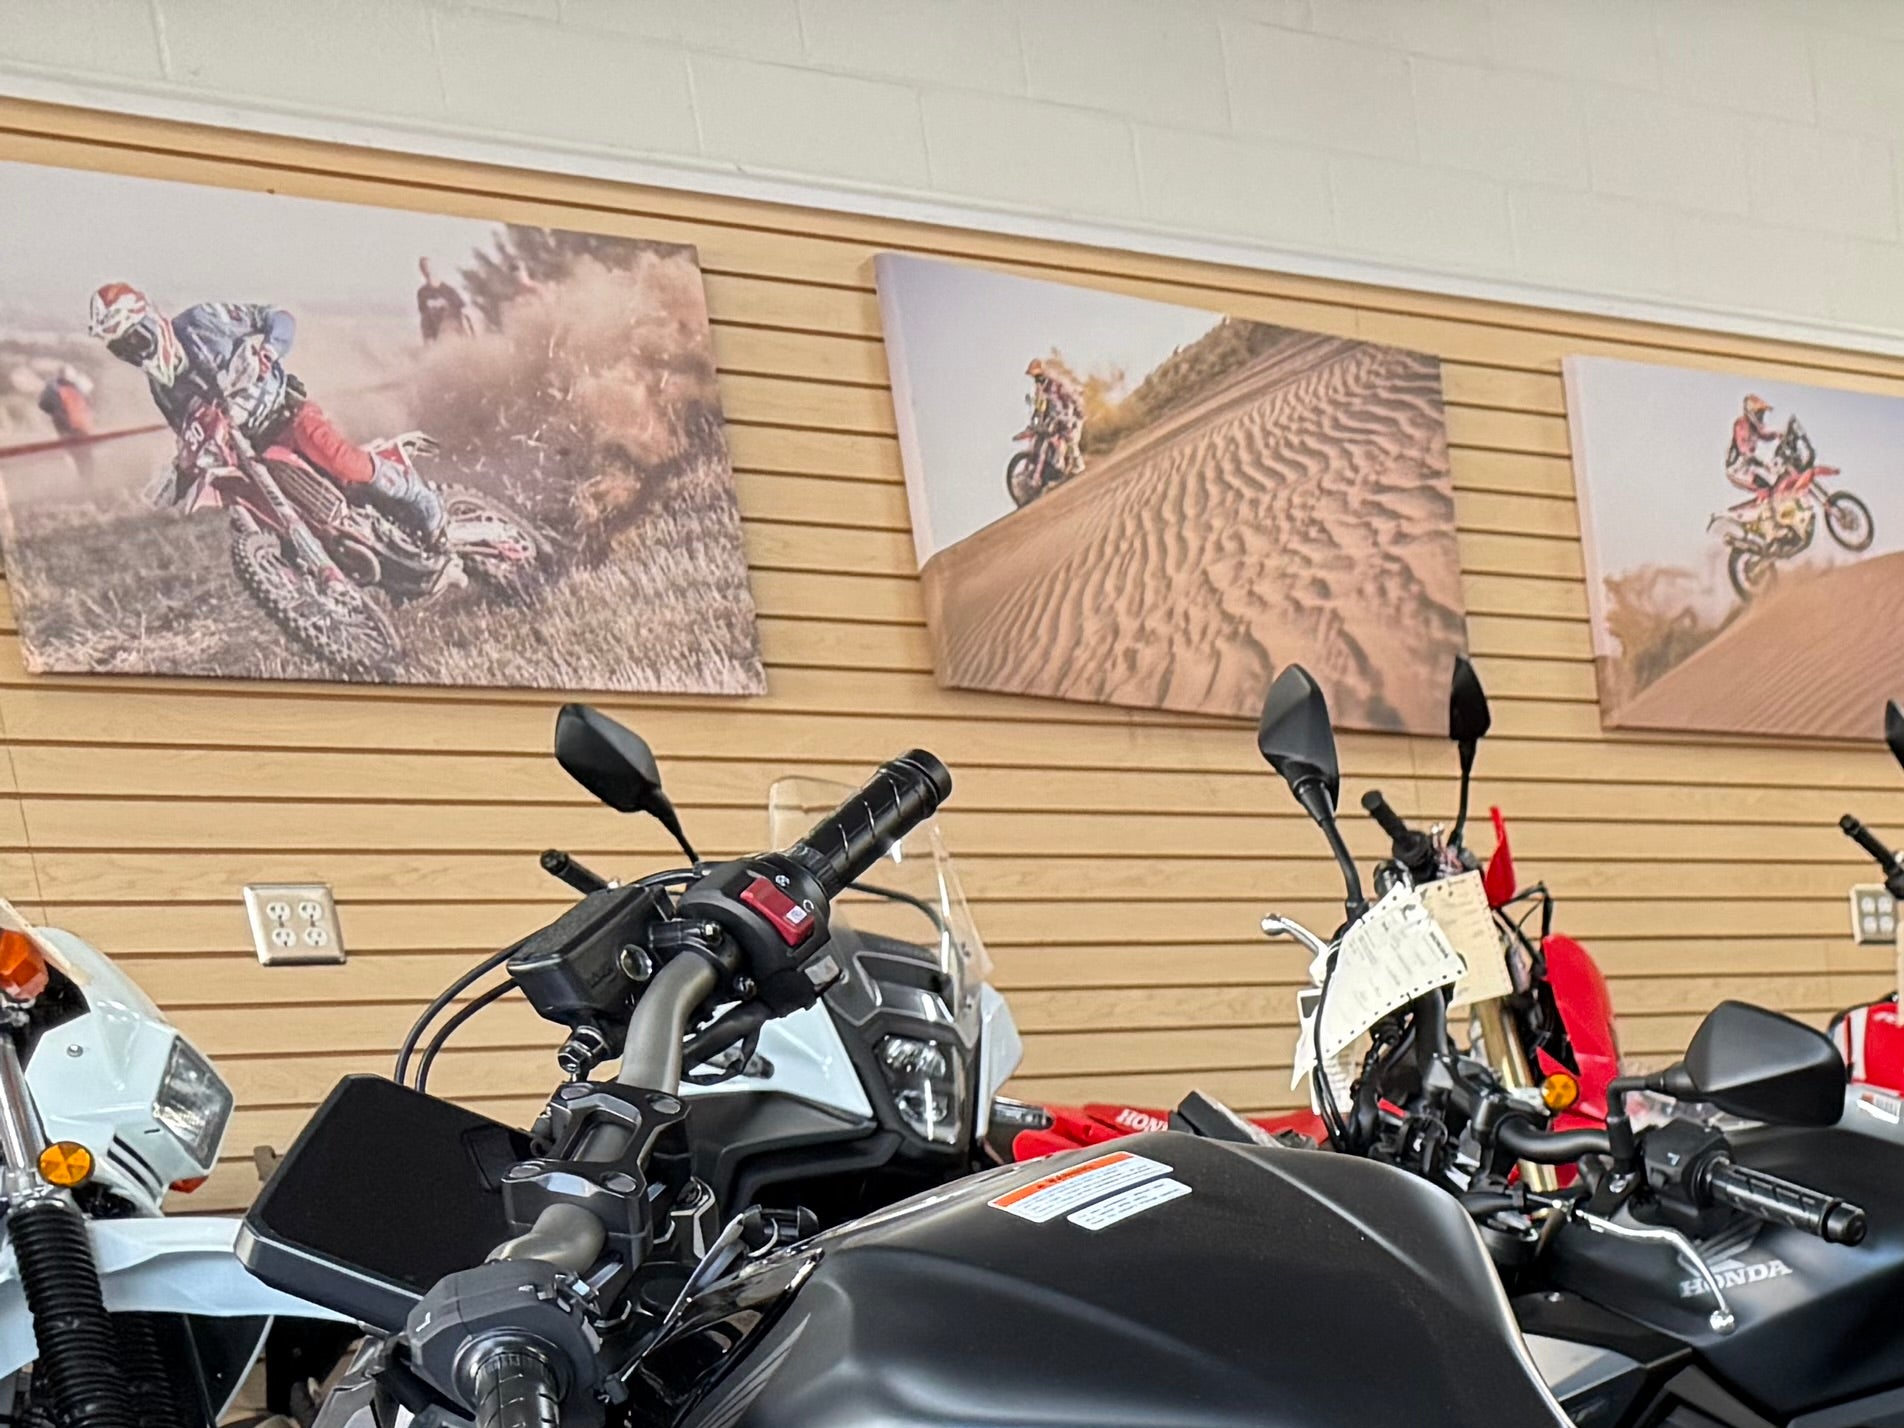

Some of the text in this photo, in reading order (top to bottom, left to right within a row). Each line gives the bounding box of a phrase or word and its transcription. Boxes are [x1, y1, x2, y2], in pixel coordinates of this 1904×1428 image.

[185, 421, 205, 451] 30
[1116, 1108, 1169, 1132] HON
[1681, 1259, 1794, 1297] HONDA
